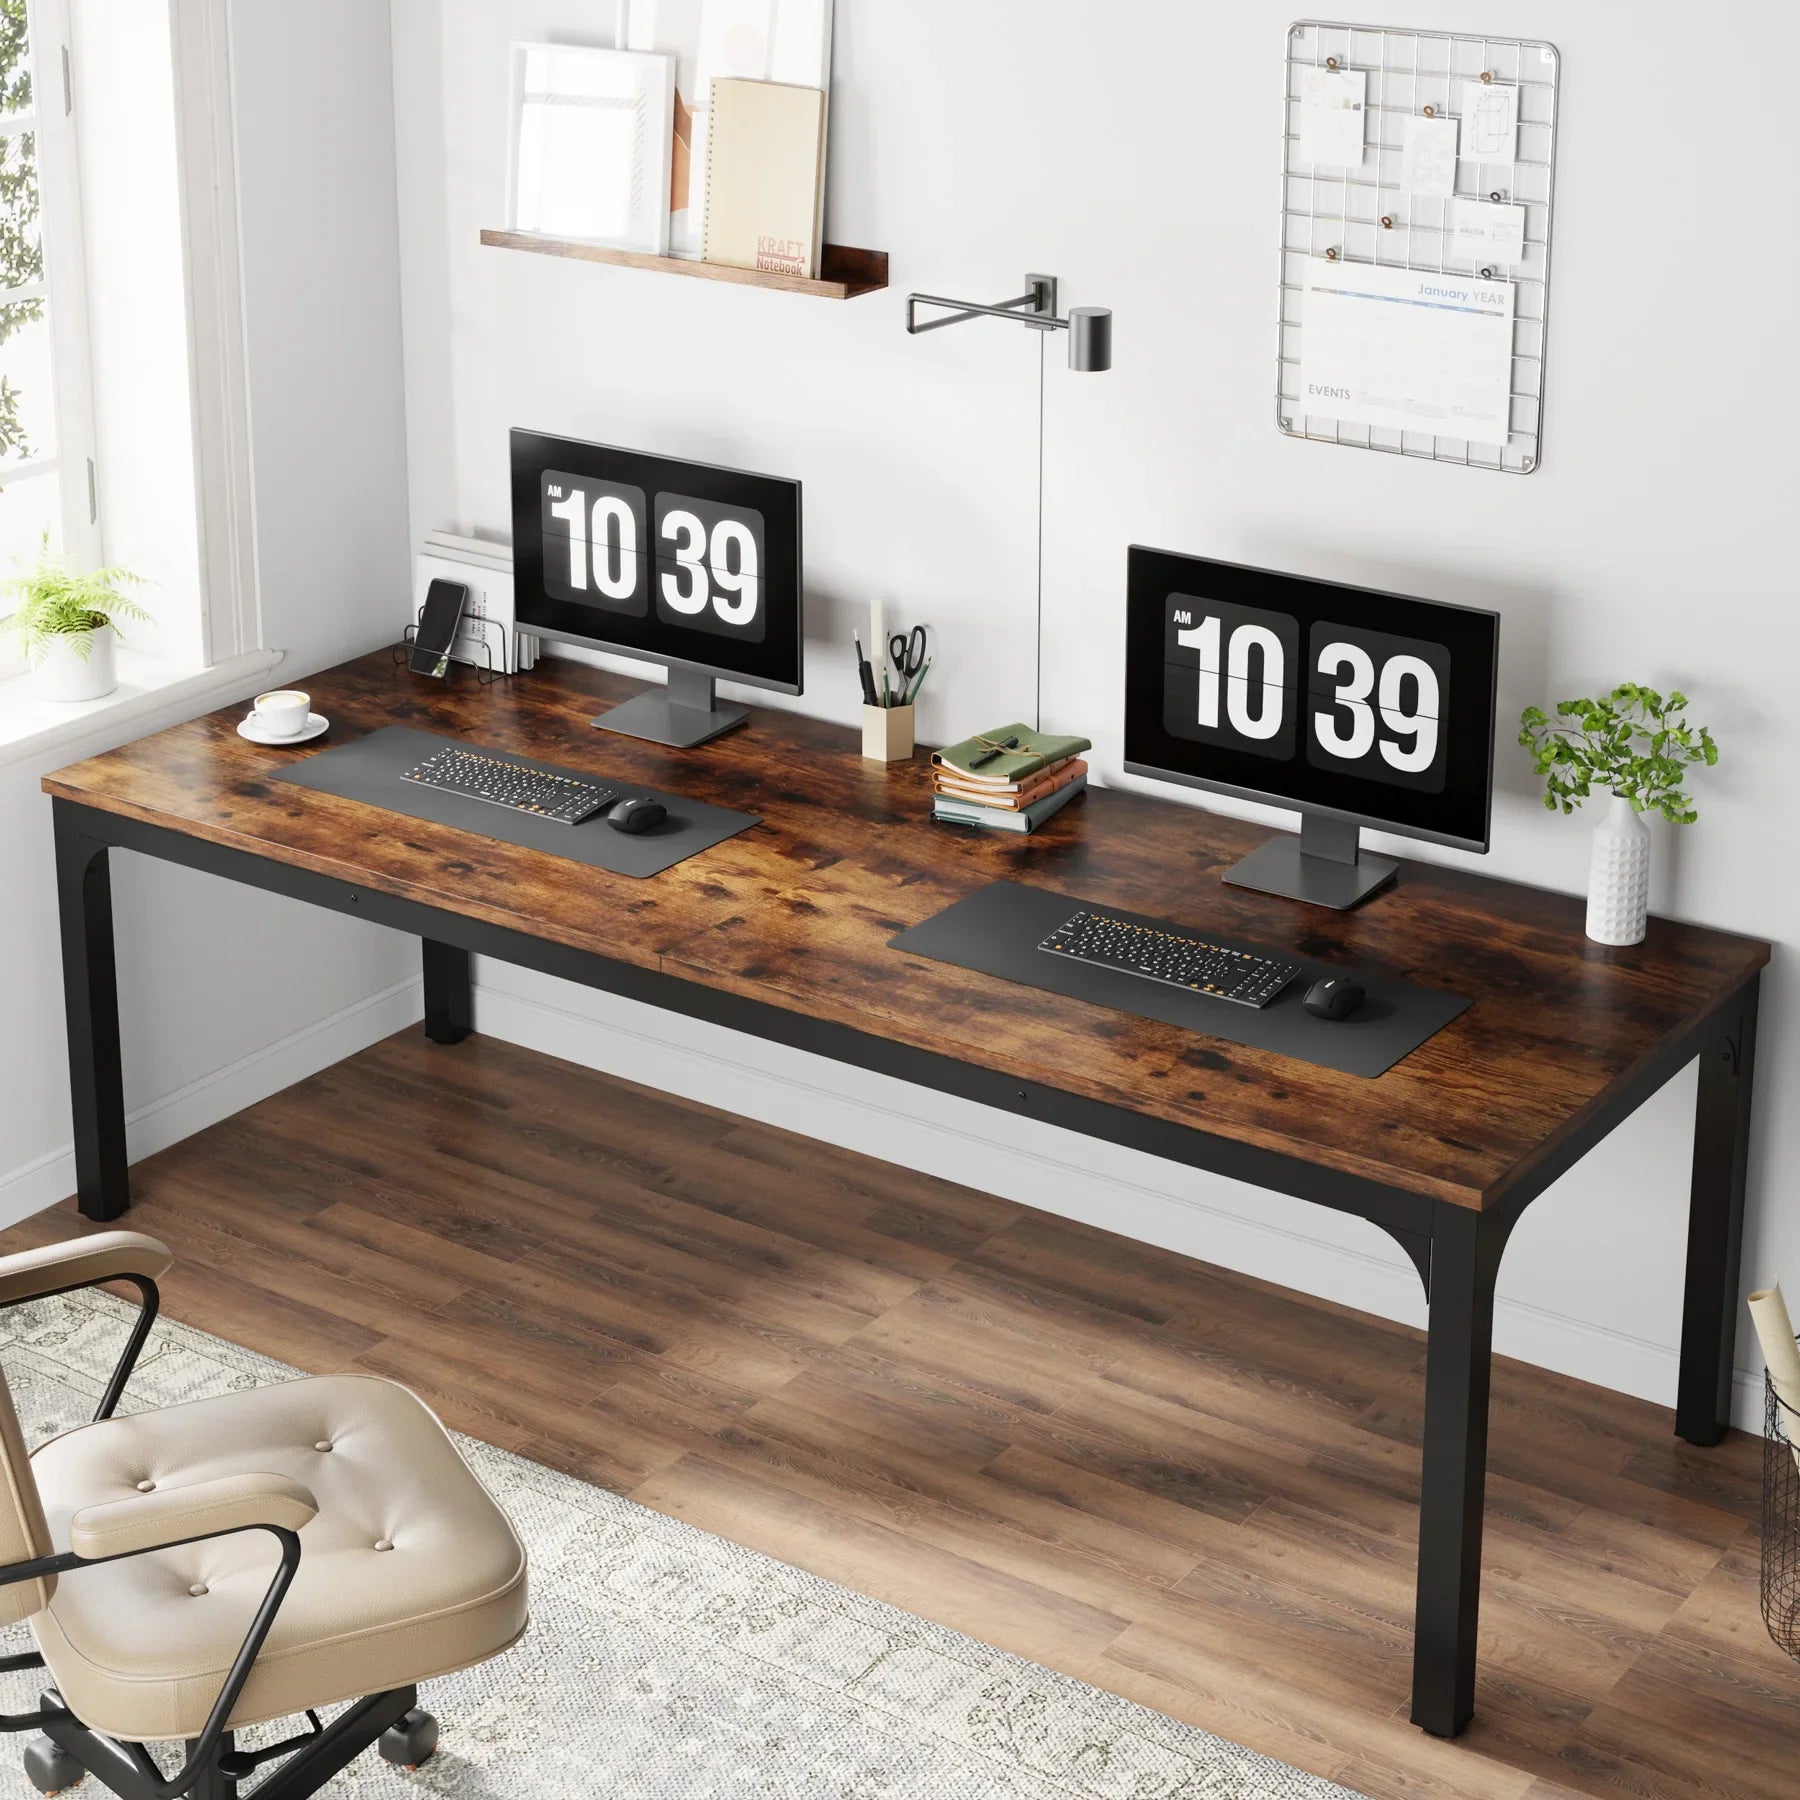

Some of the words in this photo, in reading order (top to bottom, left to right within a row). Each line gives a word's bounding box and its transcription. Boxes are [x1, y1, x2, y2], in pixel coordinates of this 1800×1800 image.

[758, 235, 804, 258] KRAFT
[757, 256, 802, 276] Notebook
[1418, 284, 1468, 301] January
[1473, 291, 1504, 305] YEAR
[1308, 384, 1351, 400] EVENTS
[547, 484, 562, 498] AM
[551, 489, 637, 600] 10
[661, 510, 758, 626] 39
[1173, 609, 1192, 625] AM
[1177, 615, 1285, 740] 10
[1314, 641, 1440, 773] 39
